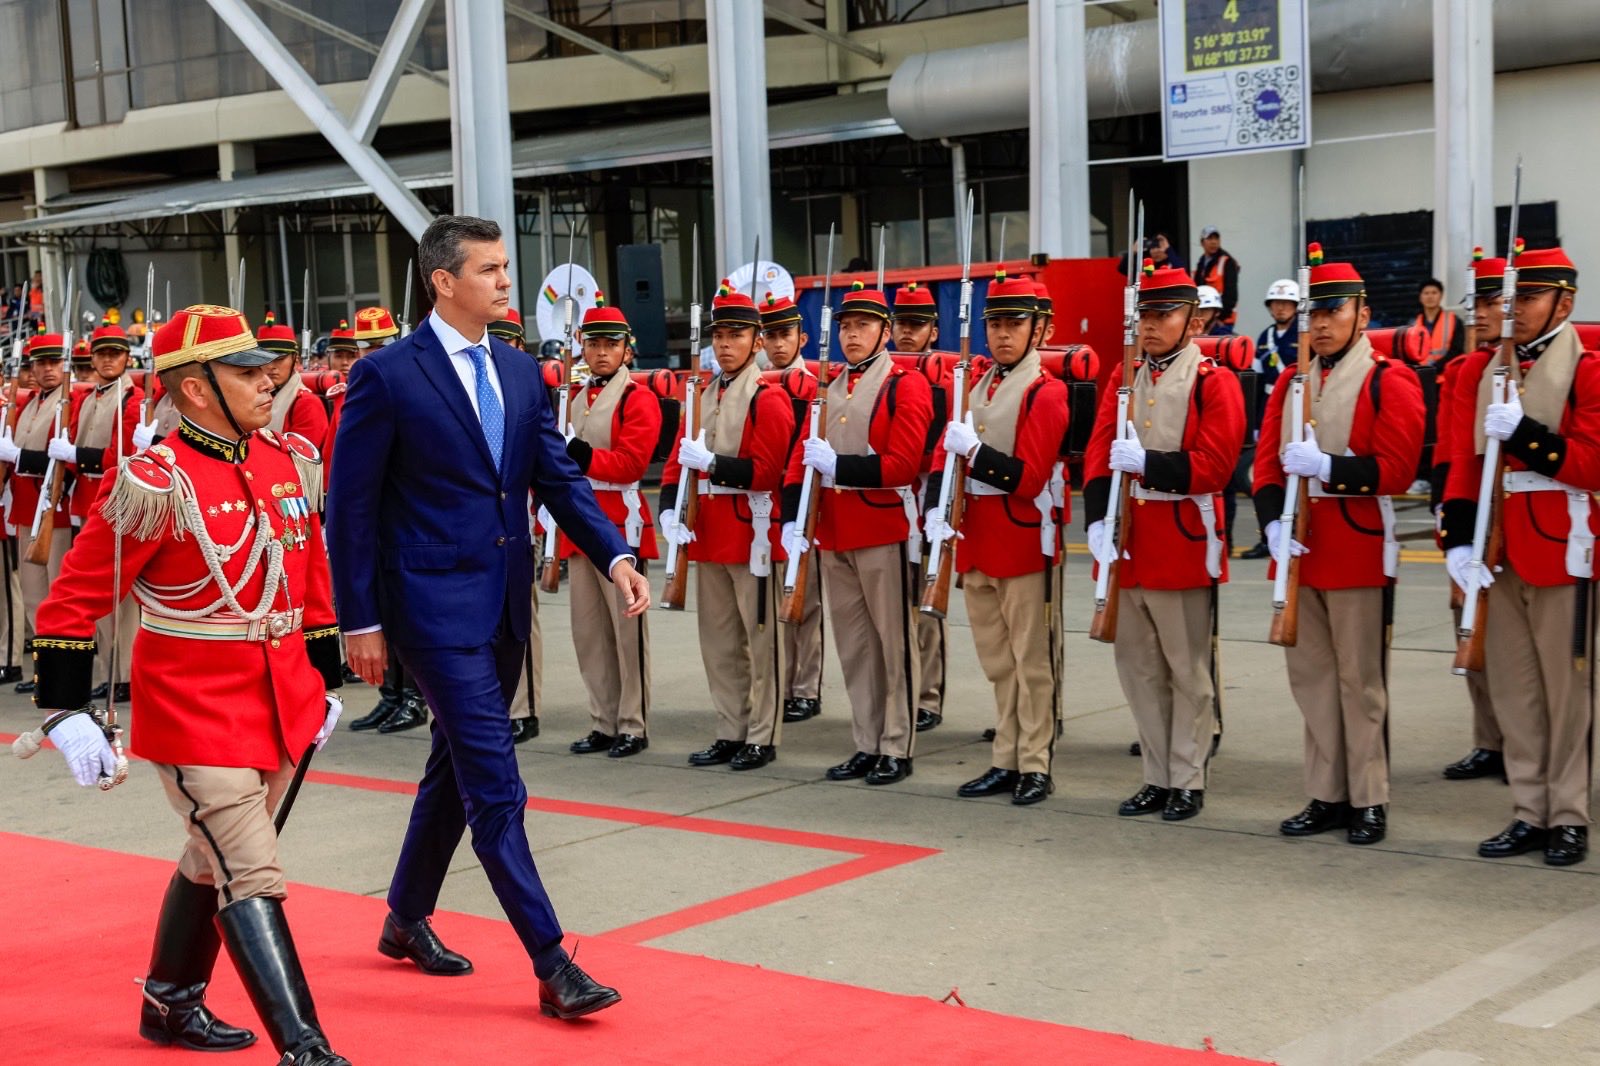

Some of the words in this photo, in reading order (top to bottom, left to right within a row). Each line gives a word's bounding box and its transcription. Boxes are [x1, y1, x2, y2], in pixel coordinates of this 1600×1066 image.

[1223, 0, 1240, 23] 4
[1194, 36, 1202, 50] S
[1192, 53, 1204, 67] W
[1172, 108, 1208, 120] Reporte
[1211, 104, 1233, 115] SMS
[1081, 352, 1090, 380] 1
